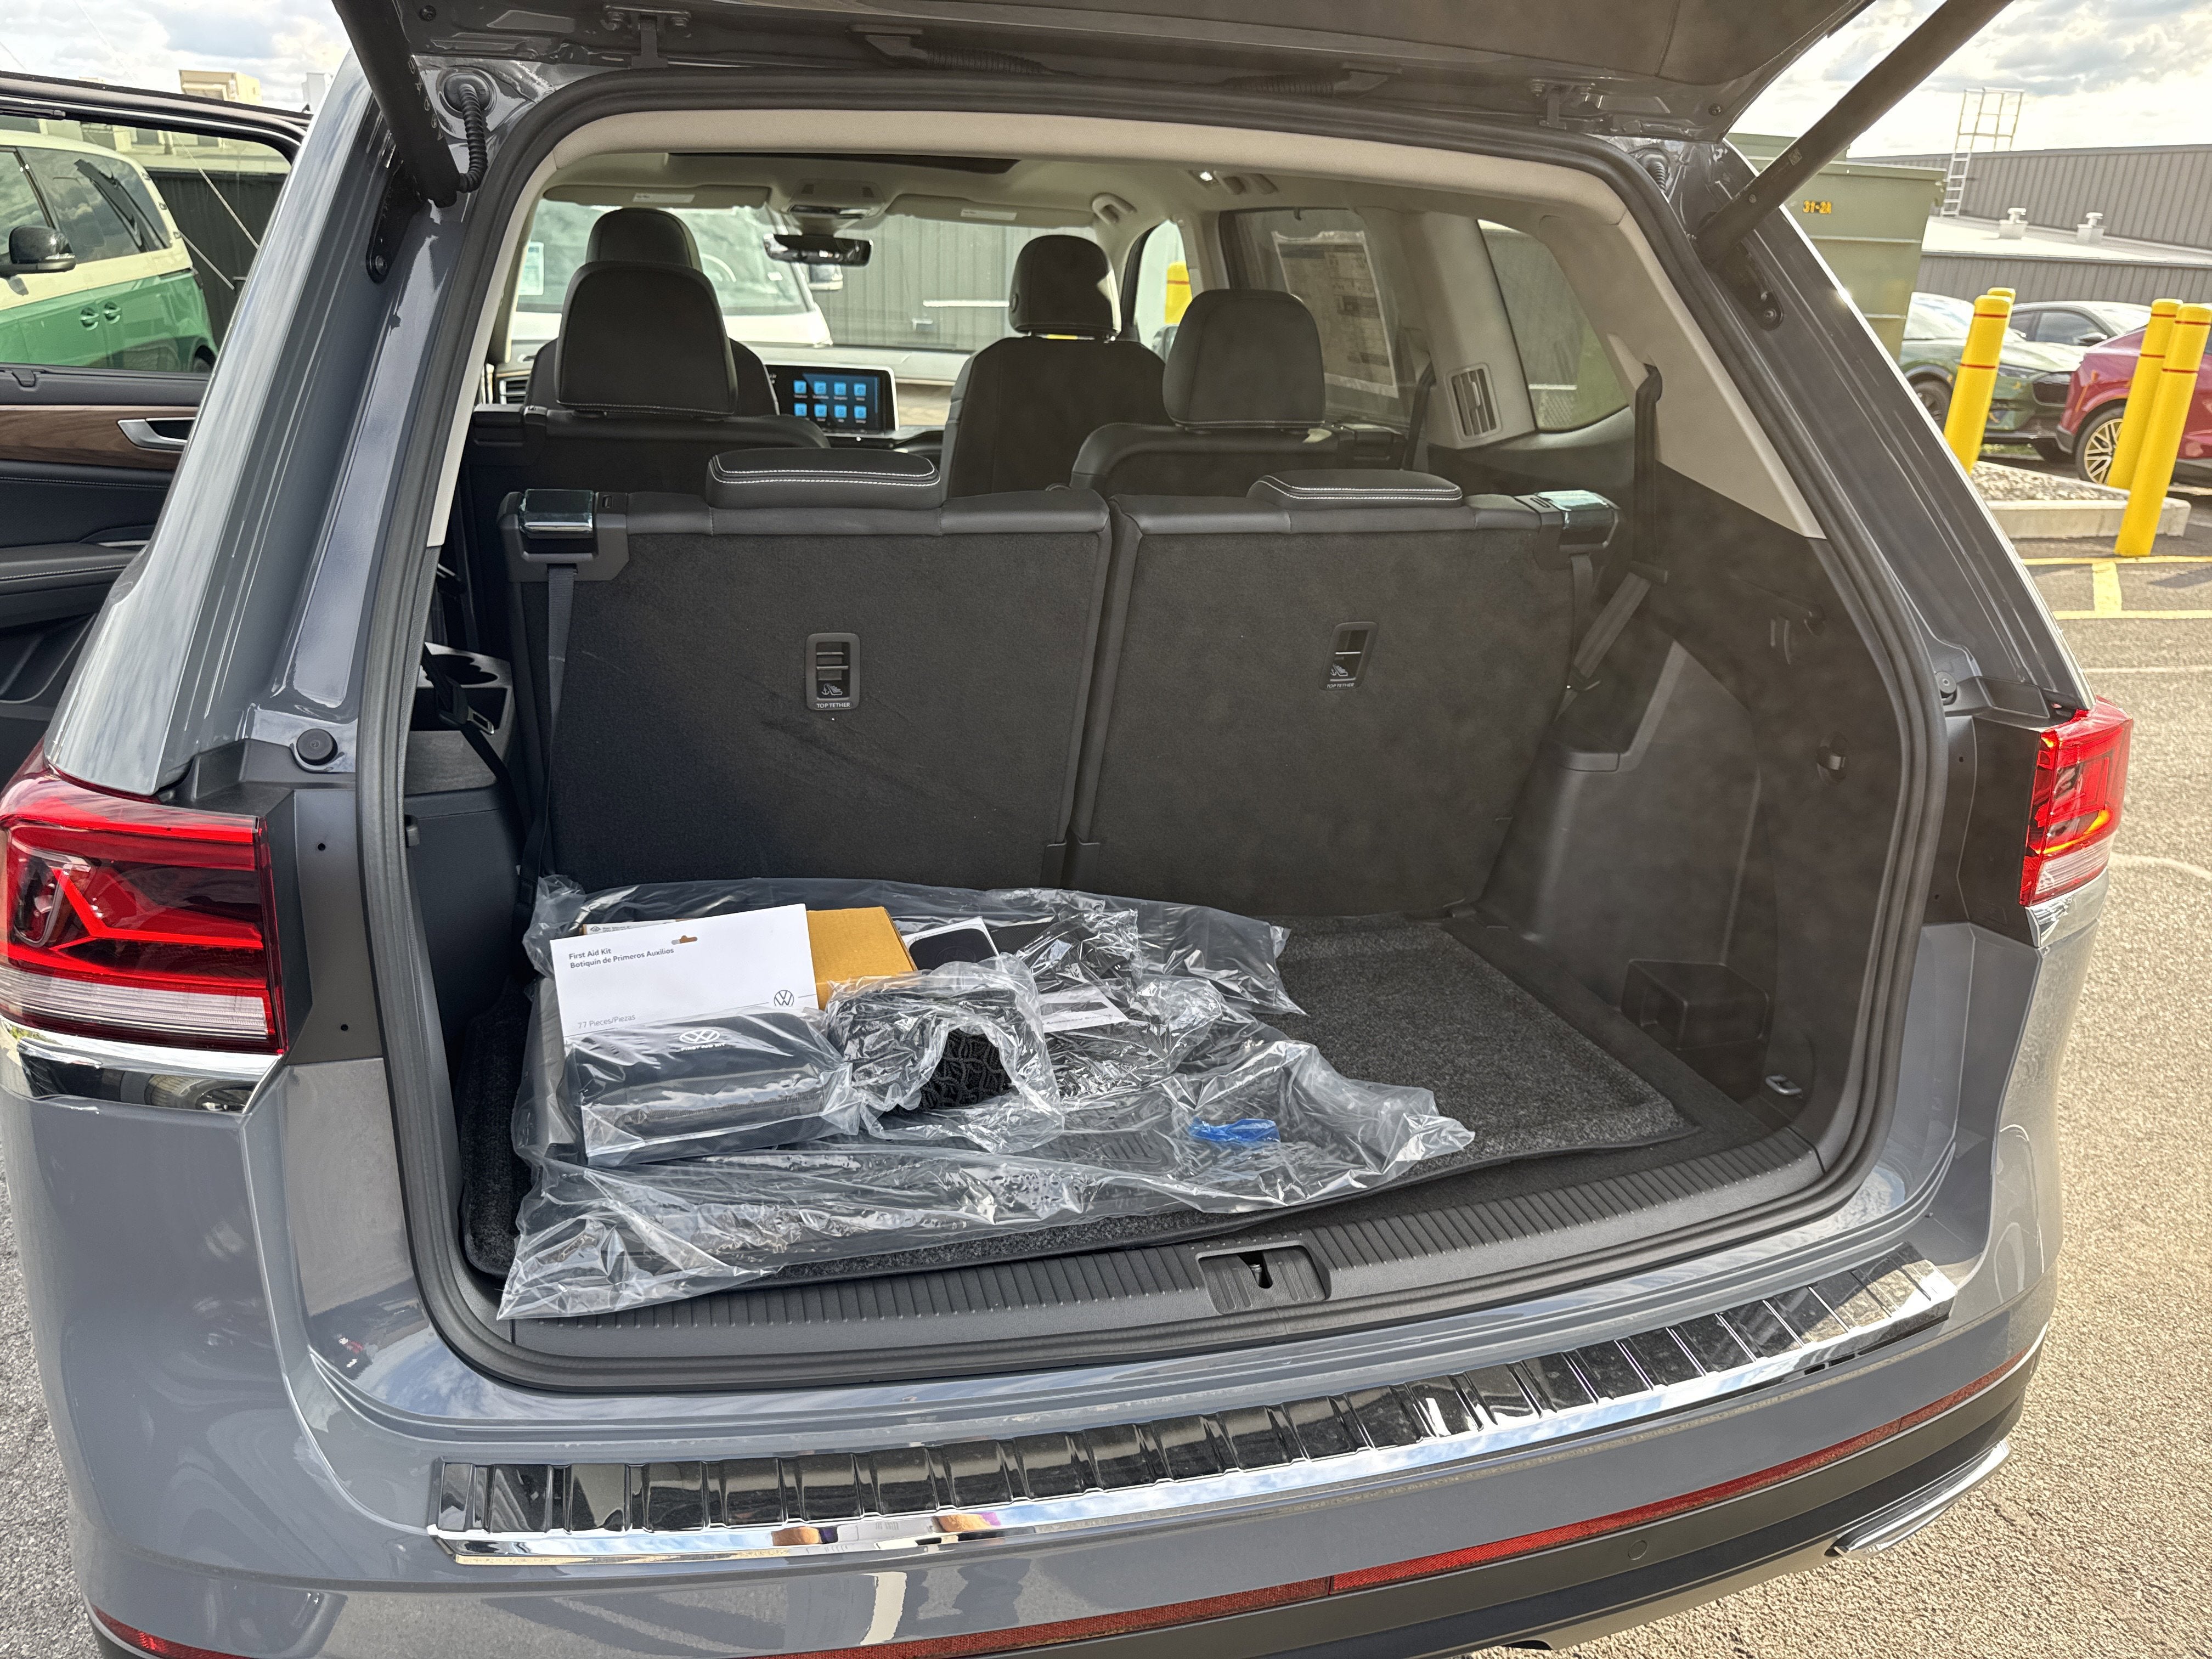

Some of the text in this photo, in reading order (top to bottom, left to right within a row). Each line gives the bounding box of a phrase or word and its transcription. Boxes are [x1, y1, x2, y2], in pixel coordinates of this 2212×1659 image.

[570, 958, 601, 969] Botiquín
[613, 952, 645, 962] Primeros
[646, 948, 674, 957] Auxilios
[588, 949, 600, 957] Aid
[589, 1015, 636, 1027] Pieces/Piezas
